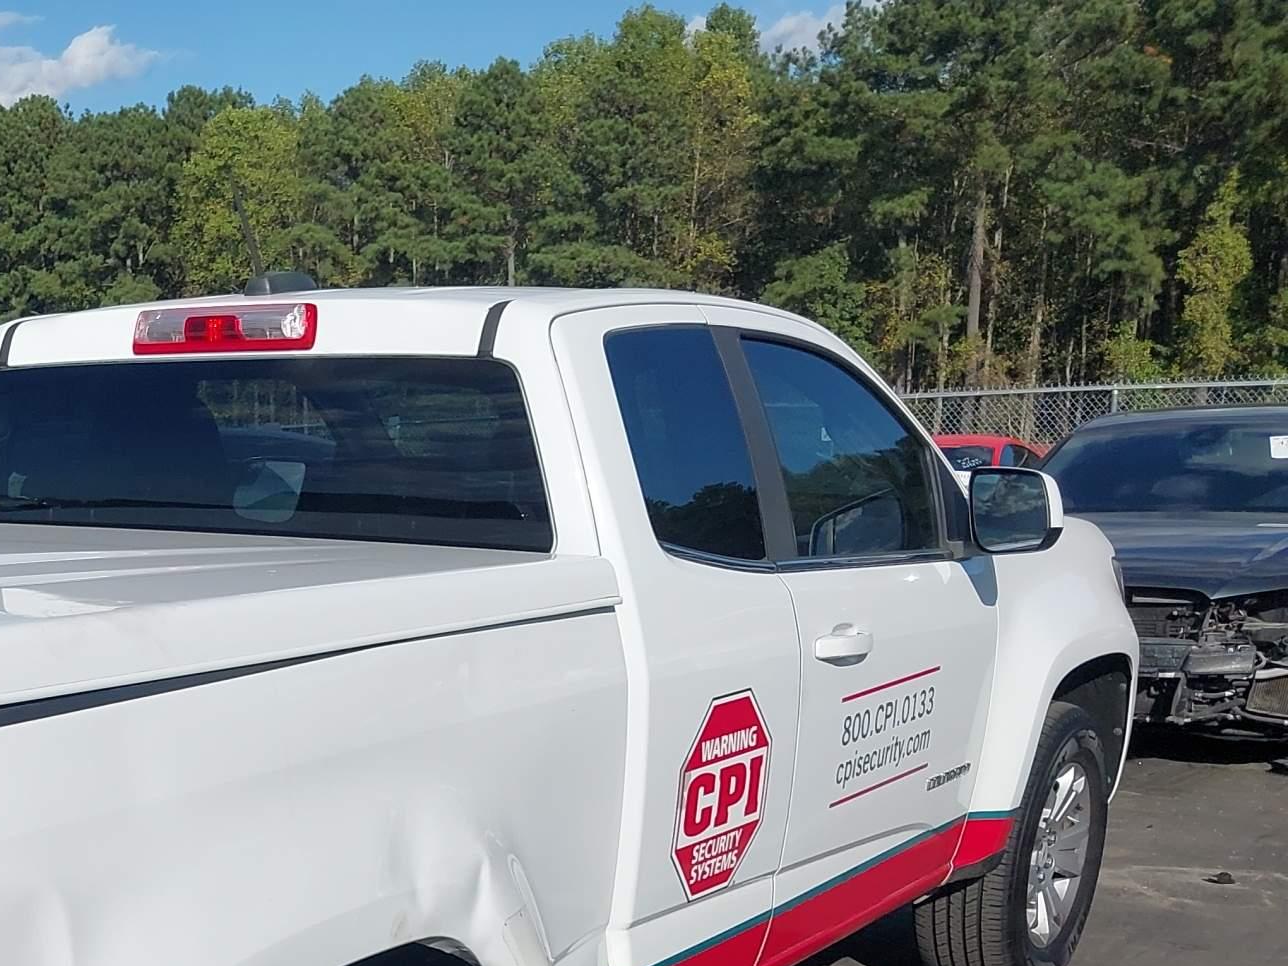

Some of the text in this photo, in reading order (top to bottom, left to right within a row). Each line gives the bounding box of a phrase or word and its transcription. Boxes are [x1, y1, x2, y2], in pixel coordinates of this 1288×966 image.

[841, 686, 935, 746] 800.CPI.0133
[701, 725, 758, 762] WARNING
[836, 729, 931, 789] cpisecurity.com
[683, 754, 765, 837] CPI
[689, 850, 739, 885] SYSTEMS
[691, 829, 743, 864] SECURITY
